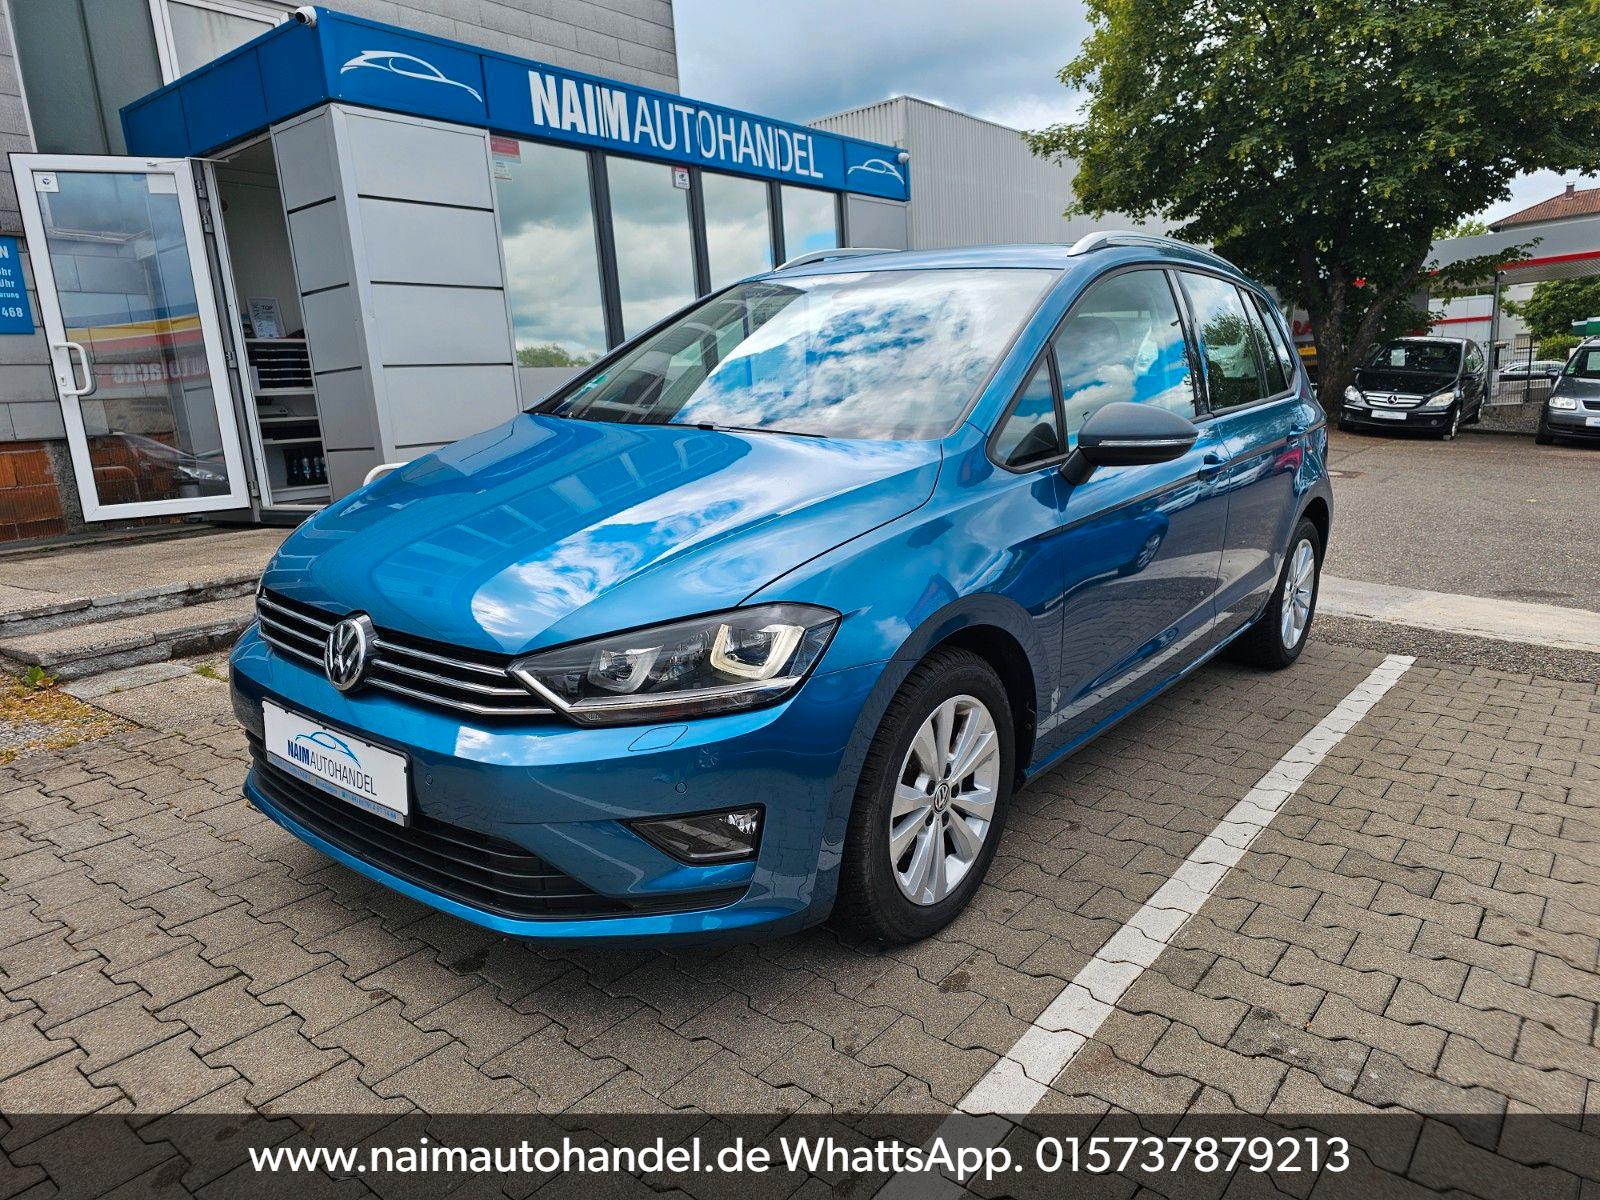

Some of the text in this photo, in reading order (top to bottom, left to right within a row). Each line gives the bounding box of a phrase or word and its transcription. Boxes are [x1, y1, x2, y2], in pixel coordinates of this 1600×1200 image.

[528, 71, 823, 178] NAIM AUTOHANDEL
[0, 267, 11, 277] hr
[1, 307, 23, 318] 468
[287, 739, 310, 765] NAIM
[310, 751, 377, 796] AUTOHANDEL
